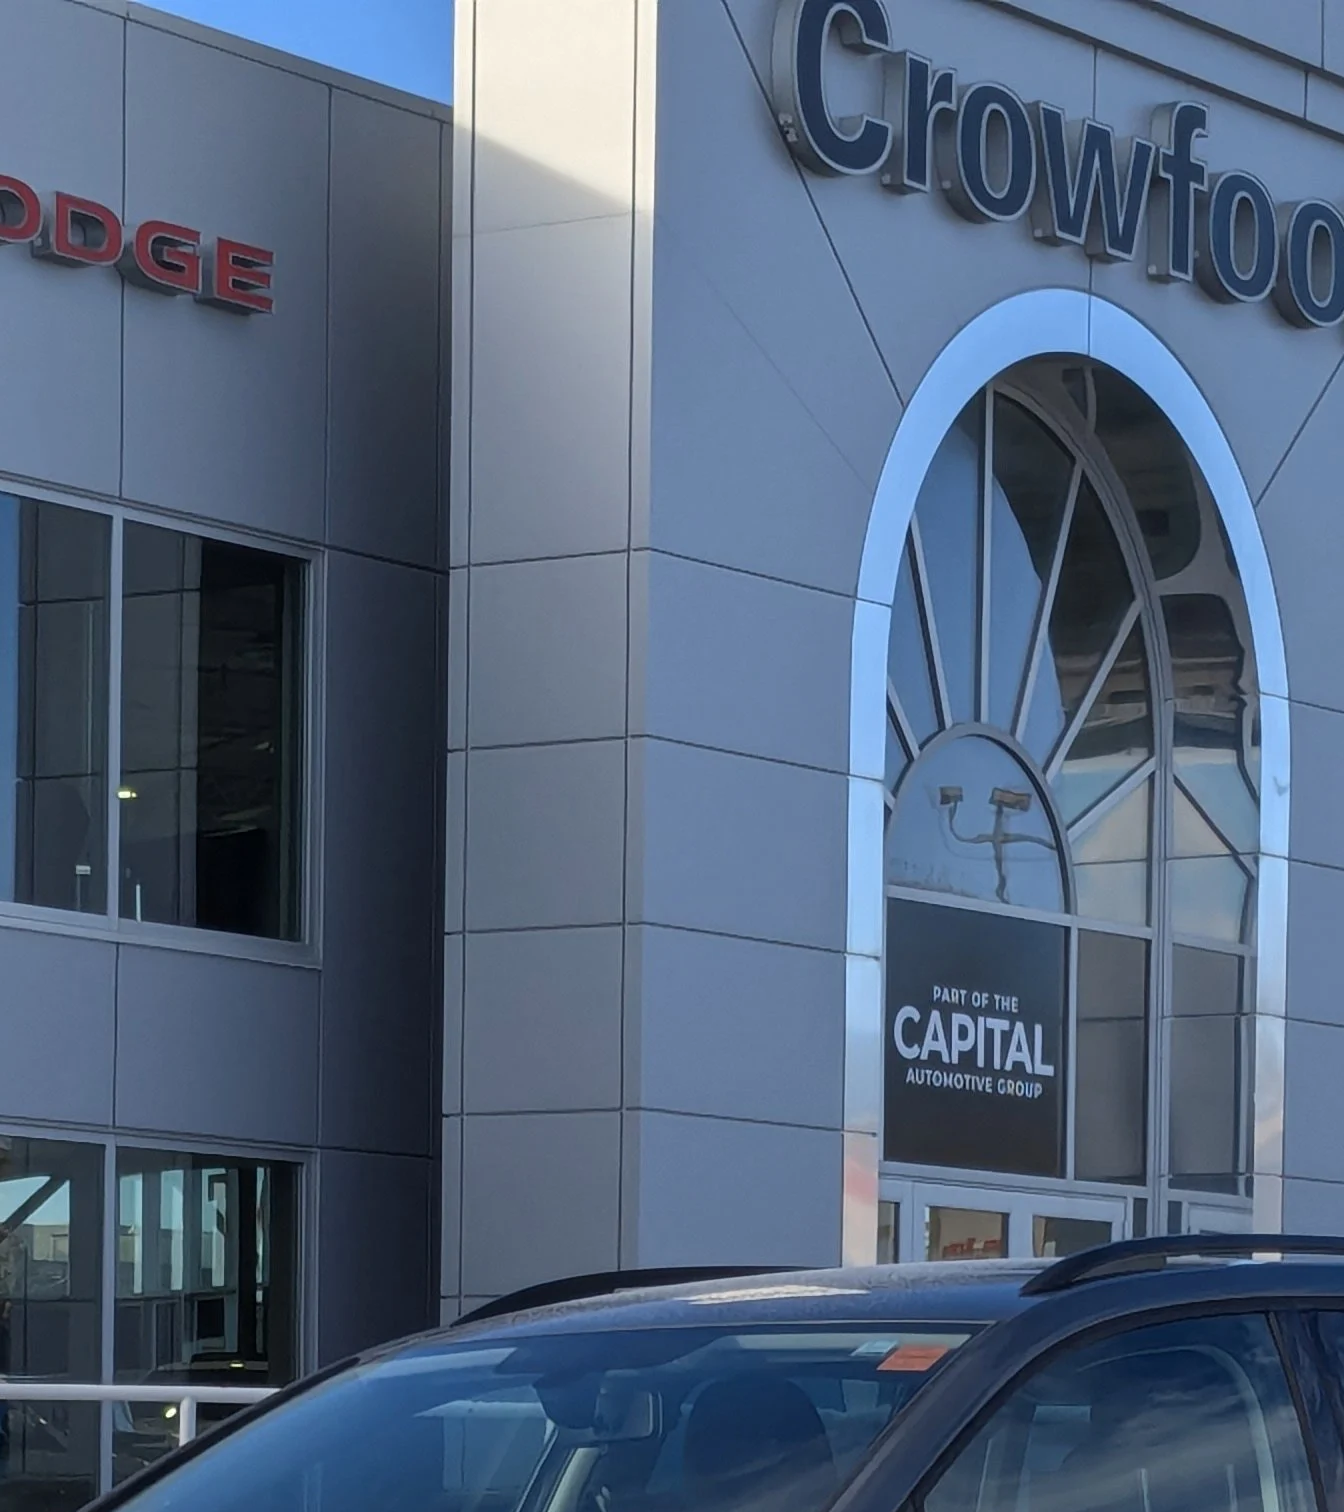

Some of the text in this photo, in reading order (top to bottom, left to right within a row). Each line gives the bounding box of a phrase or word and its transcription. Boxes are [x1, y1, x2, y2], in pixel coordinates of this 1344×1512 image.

[933, 985, 1019, 1013] PART OF THE
[893, 1005, 1055, 1077] CAPITAL
[906, 1067, 1043, 1099] AUTOMOTIVE GROUP
